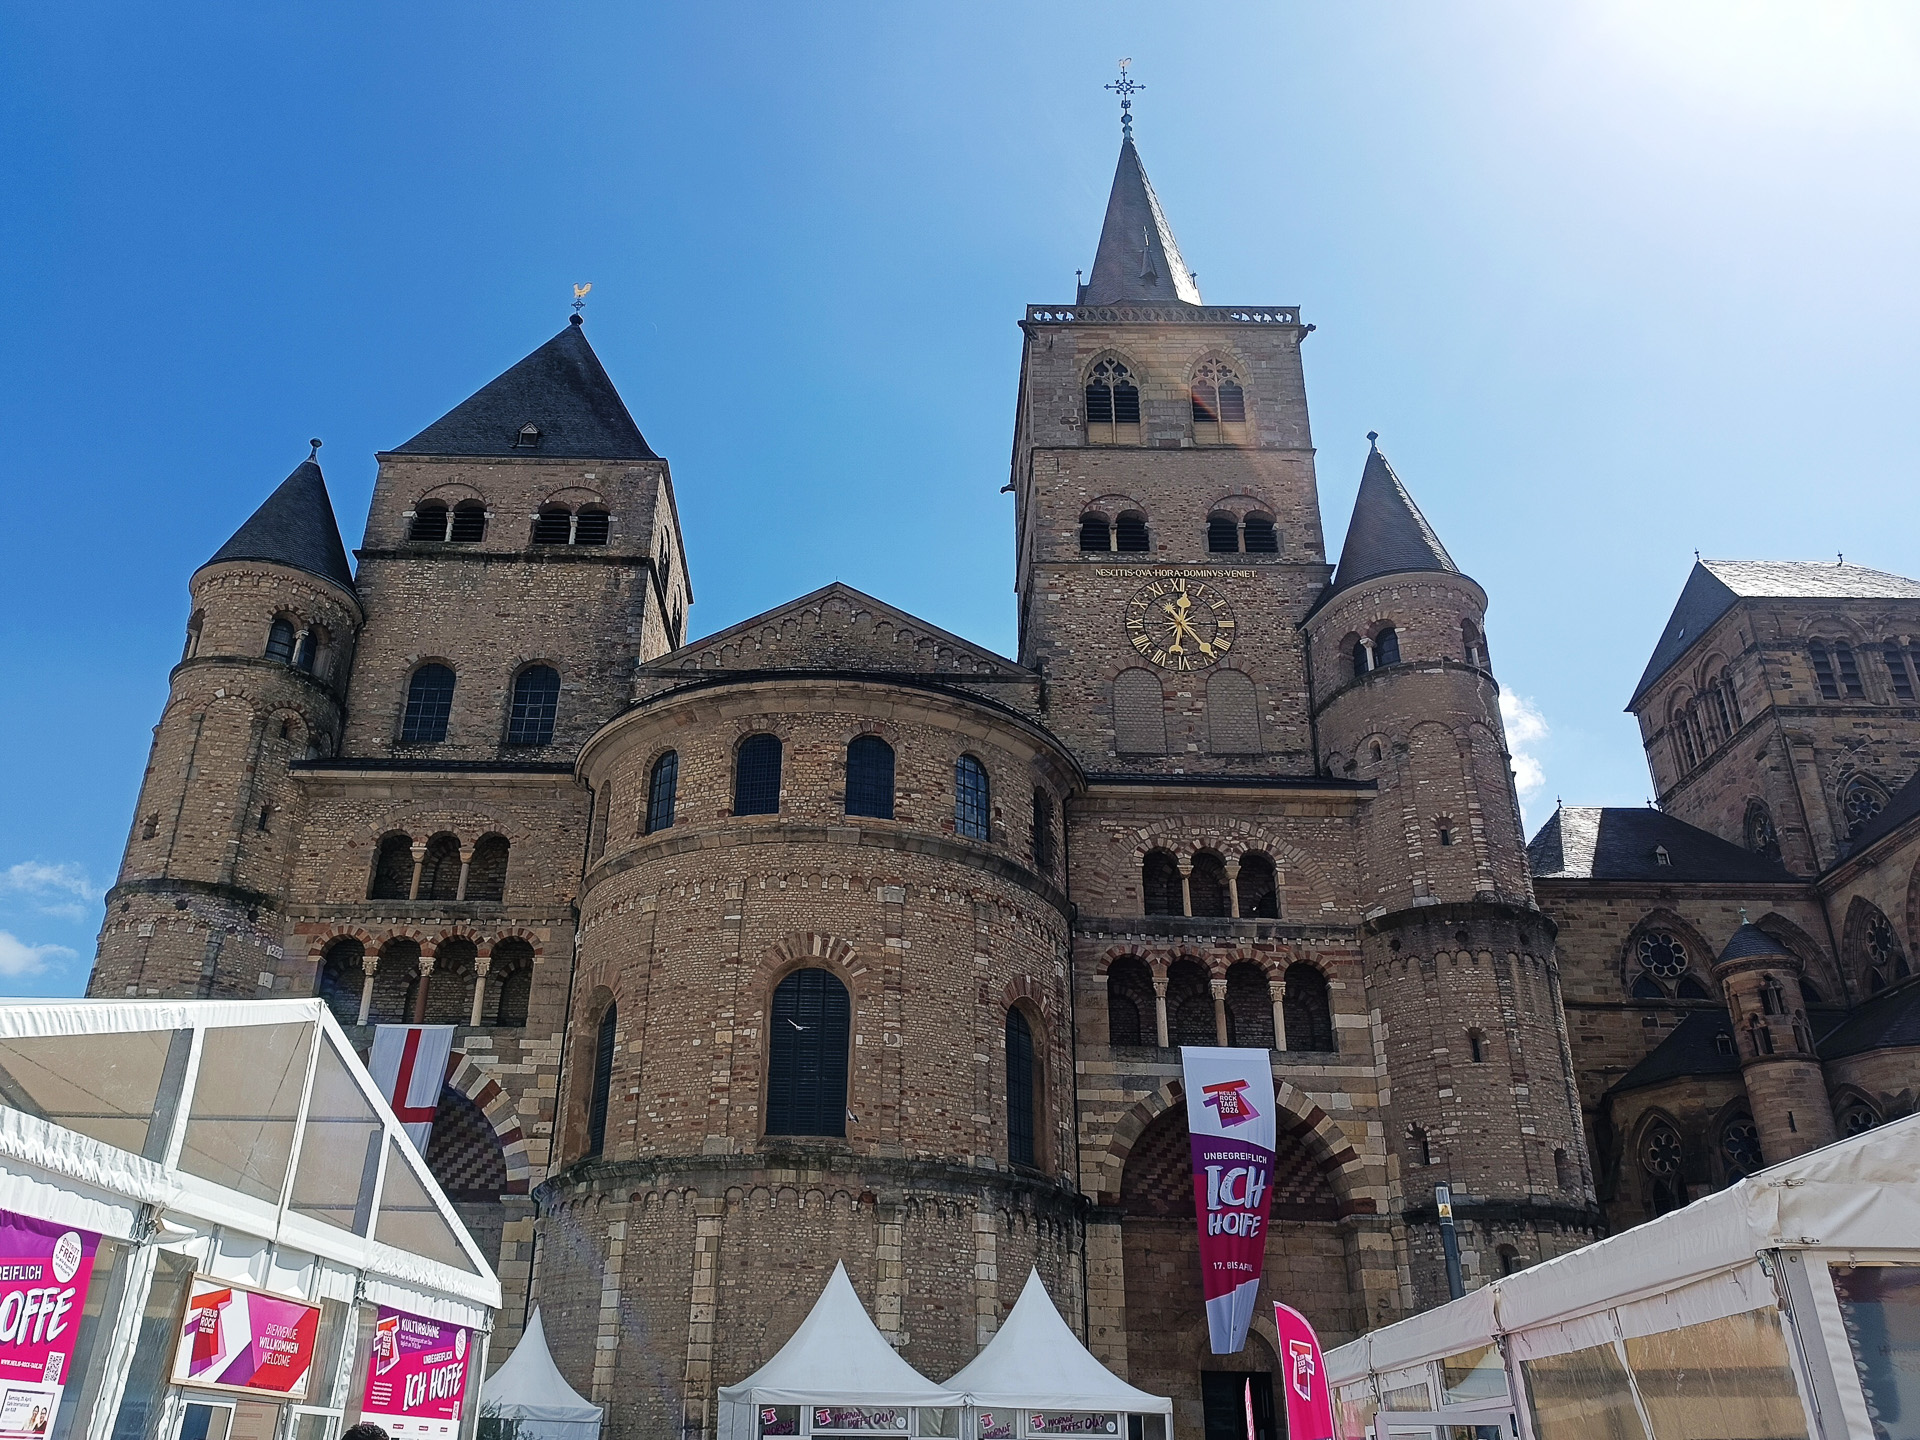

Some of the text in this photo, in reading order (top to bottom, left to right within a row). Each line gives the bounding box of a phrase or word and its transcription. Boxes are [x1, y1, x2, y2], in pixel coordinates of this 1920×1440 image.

[1203, 1152, 1267, 1164] UNBEGREIFLICH
[1204, 1165, 1266, 1211] ICH
[58, 1244, 78, 1267] FREI!
[1213, 1261, 1225, 1270] 17.
[1226, 1261, 1238, 1270] BIS
[0, 1287, 76, 1346] OFFE
[202, 1307, 218, 1318] HEILIG
[200, 1316, 217, 1328] ROCK
[265, 1323, 299, 1340] BIENVENUE
[259, 1336, 299, 1354] WILLKOMMEN
[261, 1352, 292, 1367] WELCOME
[402, 1372, 427, 1411] ICH
[429, 1362, 464, 1401] HOFFE
